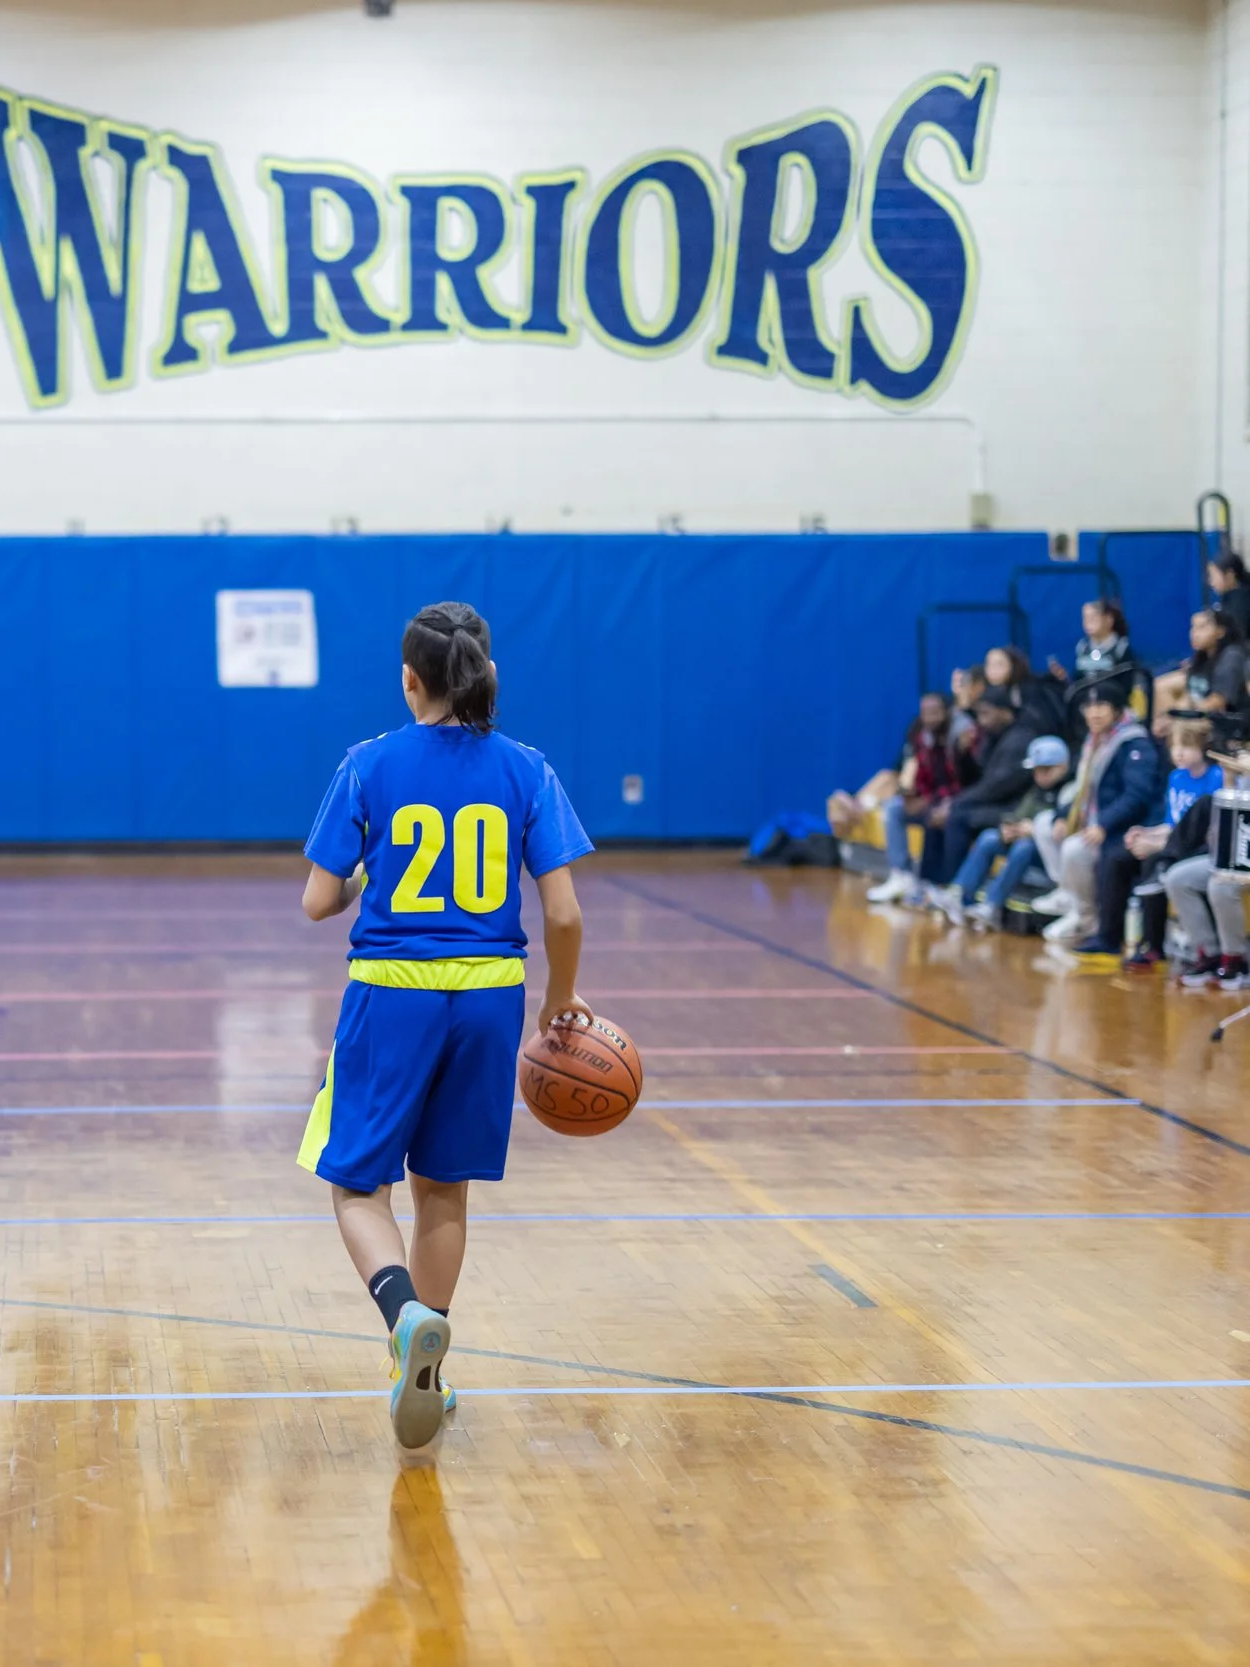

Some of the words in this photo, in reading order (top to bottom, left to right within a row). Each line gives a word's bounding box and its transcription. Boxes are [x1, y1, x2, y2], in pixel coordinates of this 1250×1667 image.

[391, 803, 509, 914] 20
[524, 1066, 560, 1112] MS
[567, 1087, 610, 1116] 50
